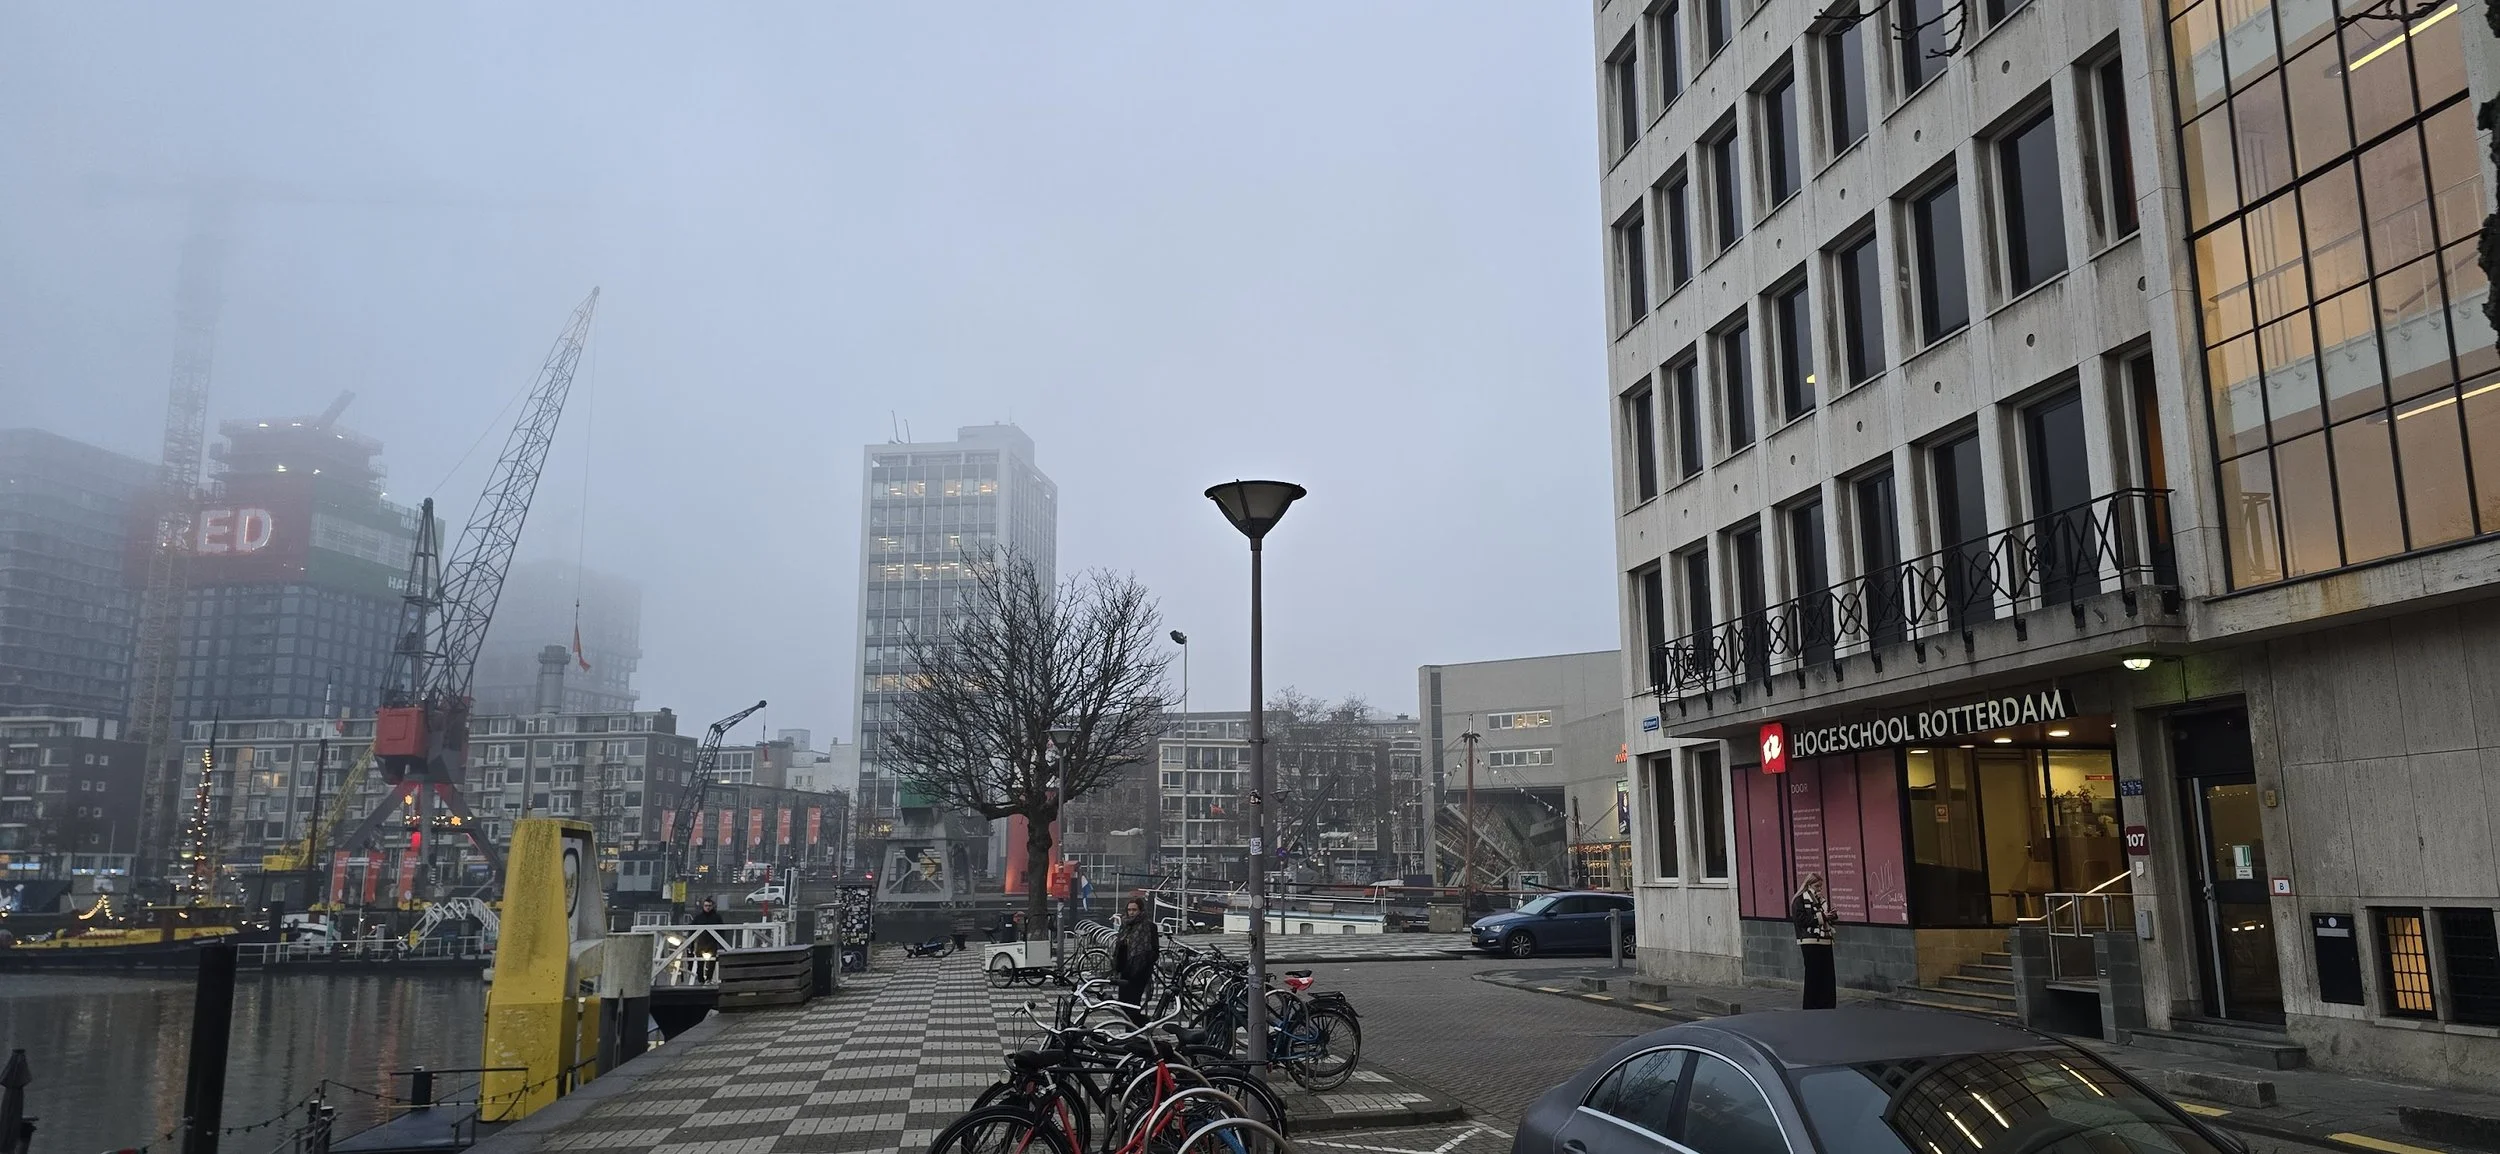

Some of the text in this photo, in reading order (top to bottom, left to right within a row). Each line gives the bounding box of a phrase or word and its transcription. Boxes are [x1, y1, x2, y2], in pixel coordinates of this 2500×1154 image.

[156, 507, 273, 553] RED
[1793, 688, 2066, 757] HOGESCHOOL ROTTERDAM
[1791, 783, 1809, 794] DOOR
[2126, 833, 2145, 848] 107
[2279, 882, 2285, 891] B
